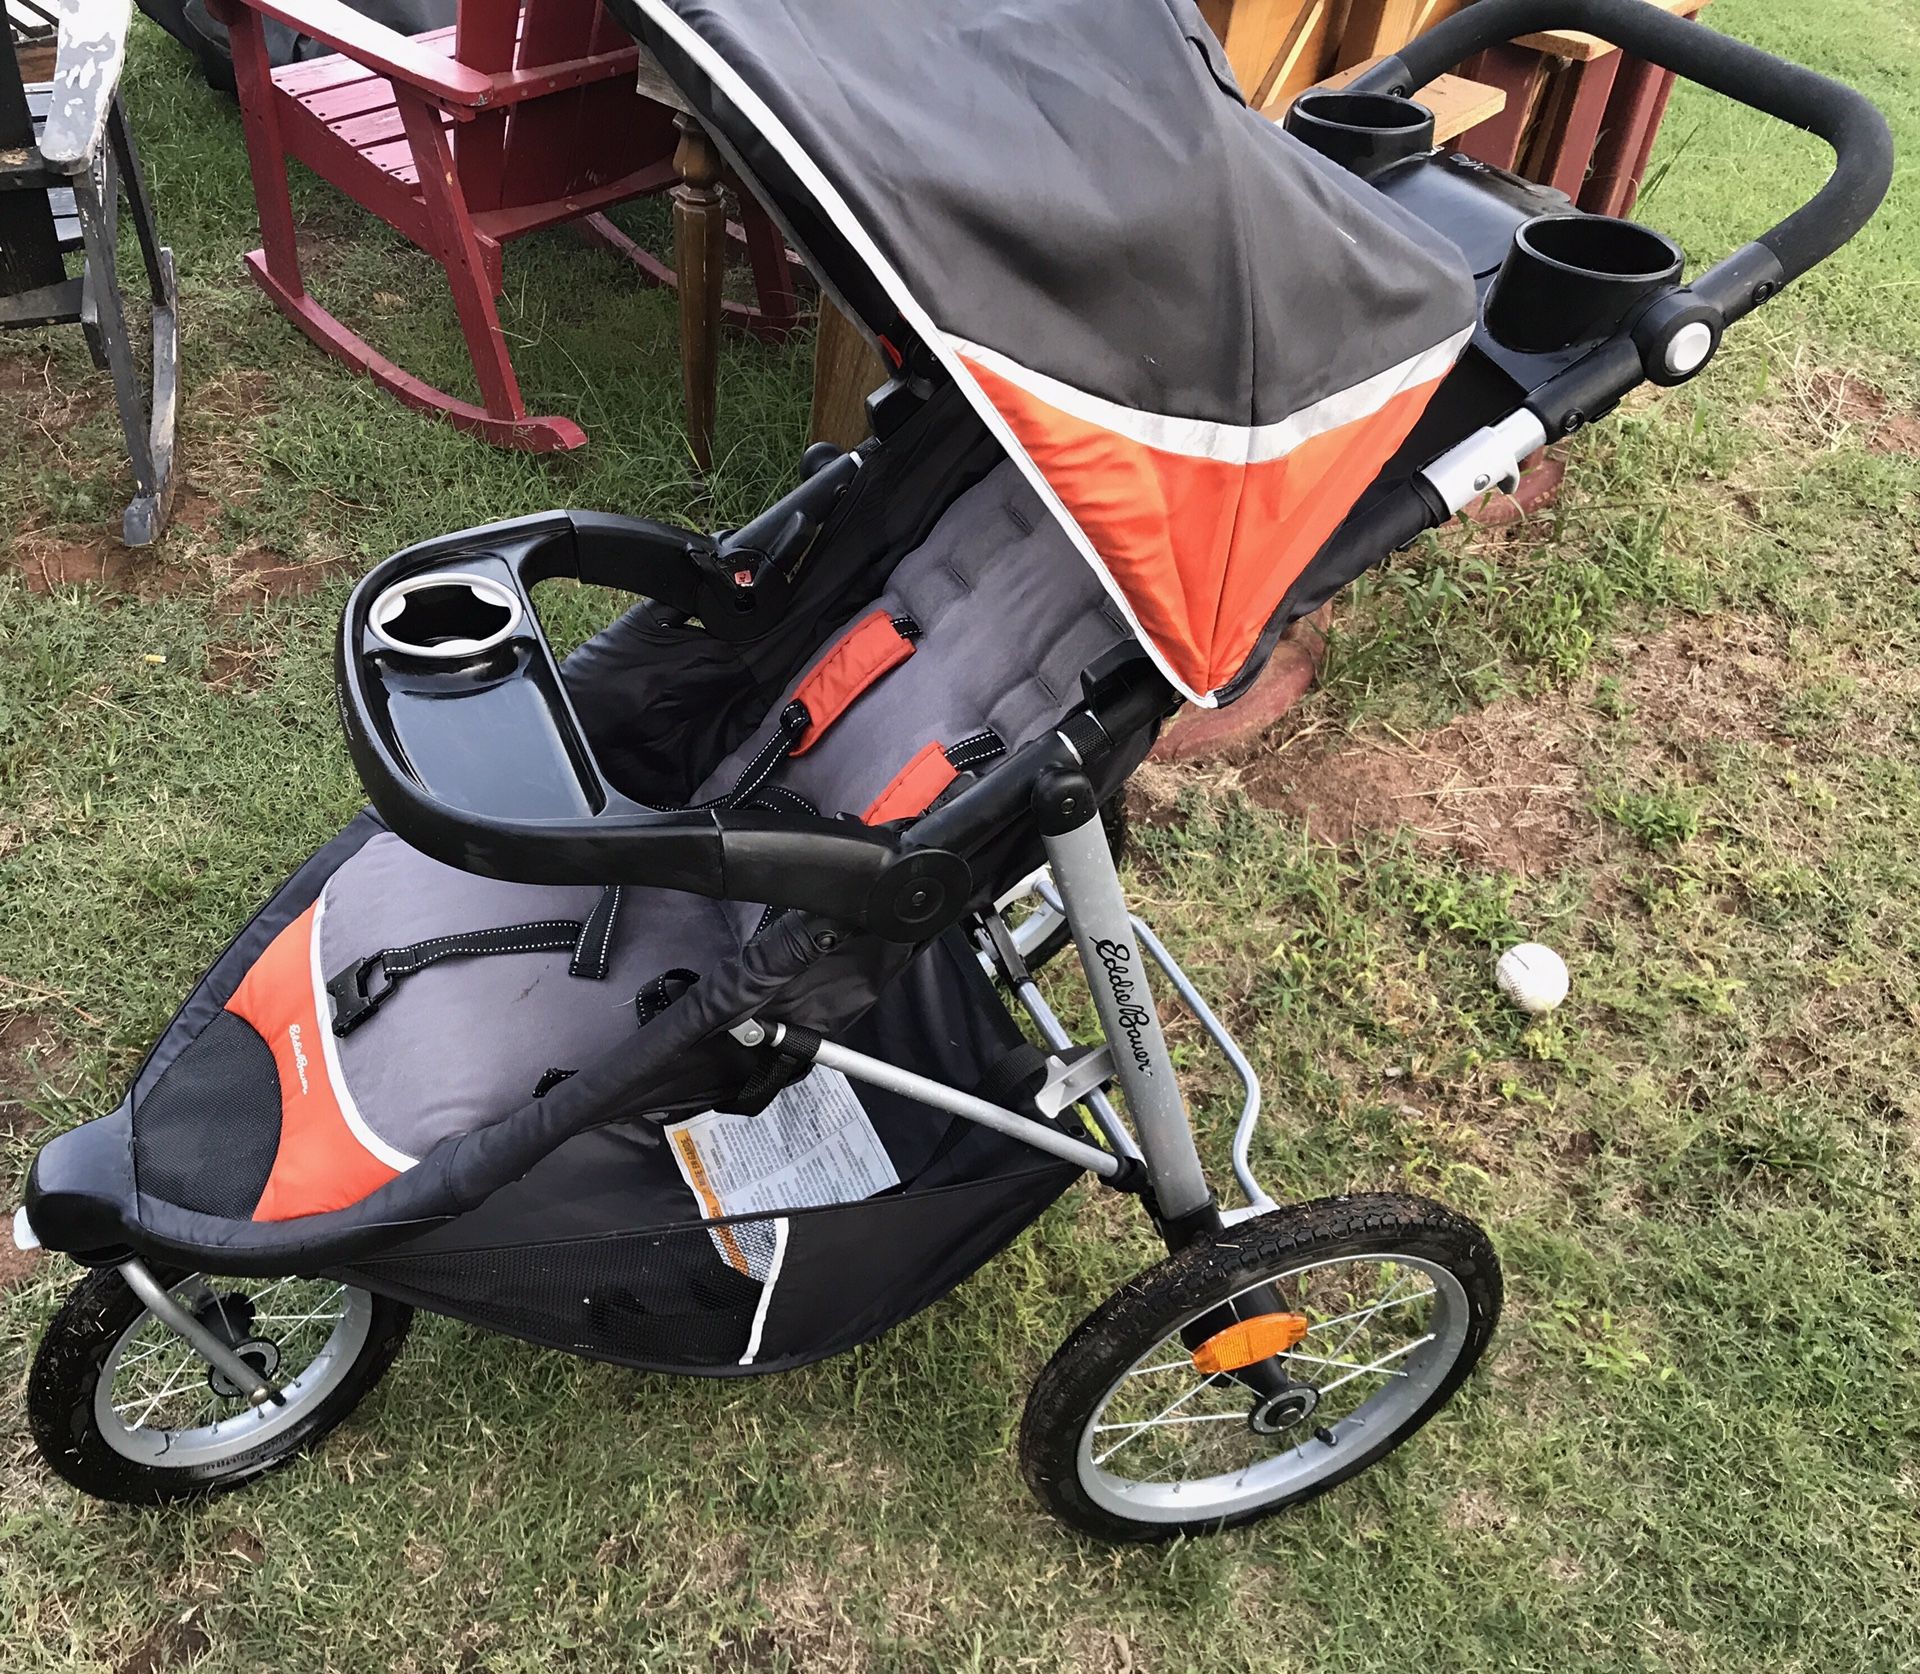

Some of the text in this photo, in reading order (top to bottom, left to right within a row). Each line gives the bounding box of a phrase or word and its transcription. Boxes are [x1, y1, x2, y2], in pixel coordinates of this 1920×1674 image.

[1089, 936, 1150, 1073] Eddie Bauer
[289, 1023, 309, 1095] Eddie Bauer
[681, 1136, 696, 1160] GARDE
